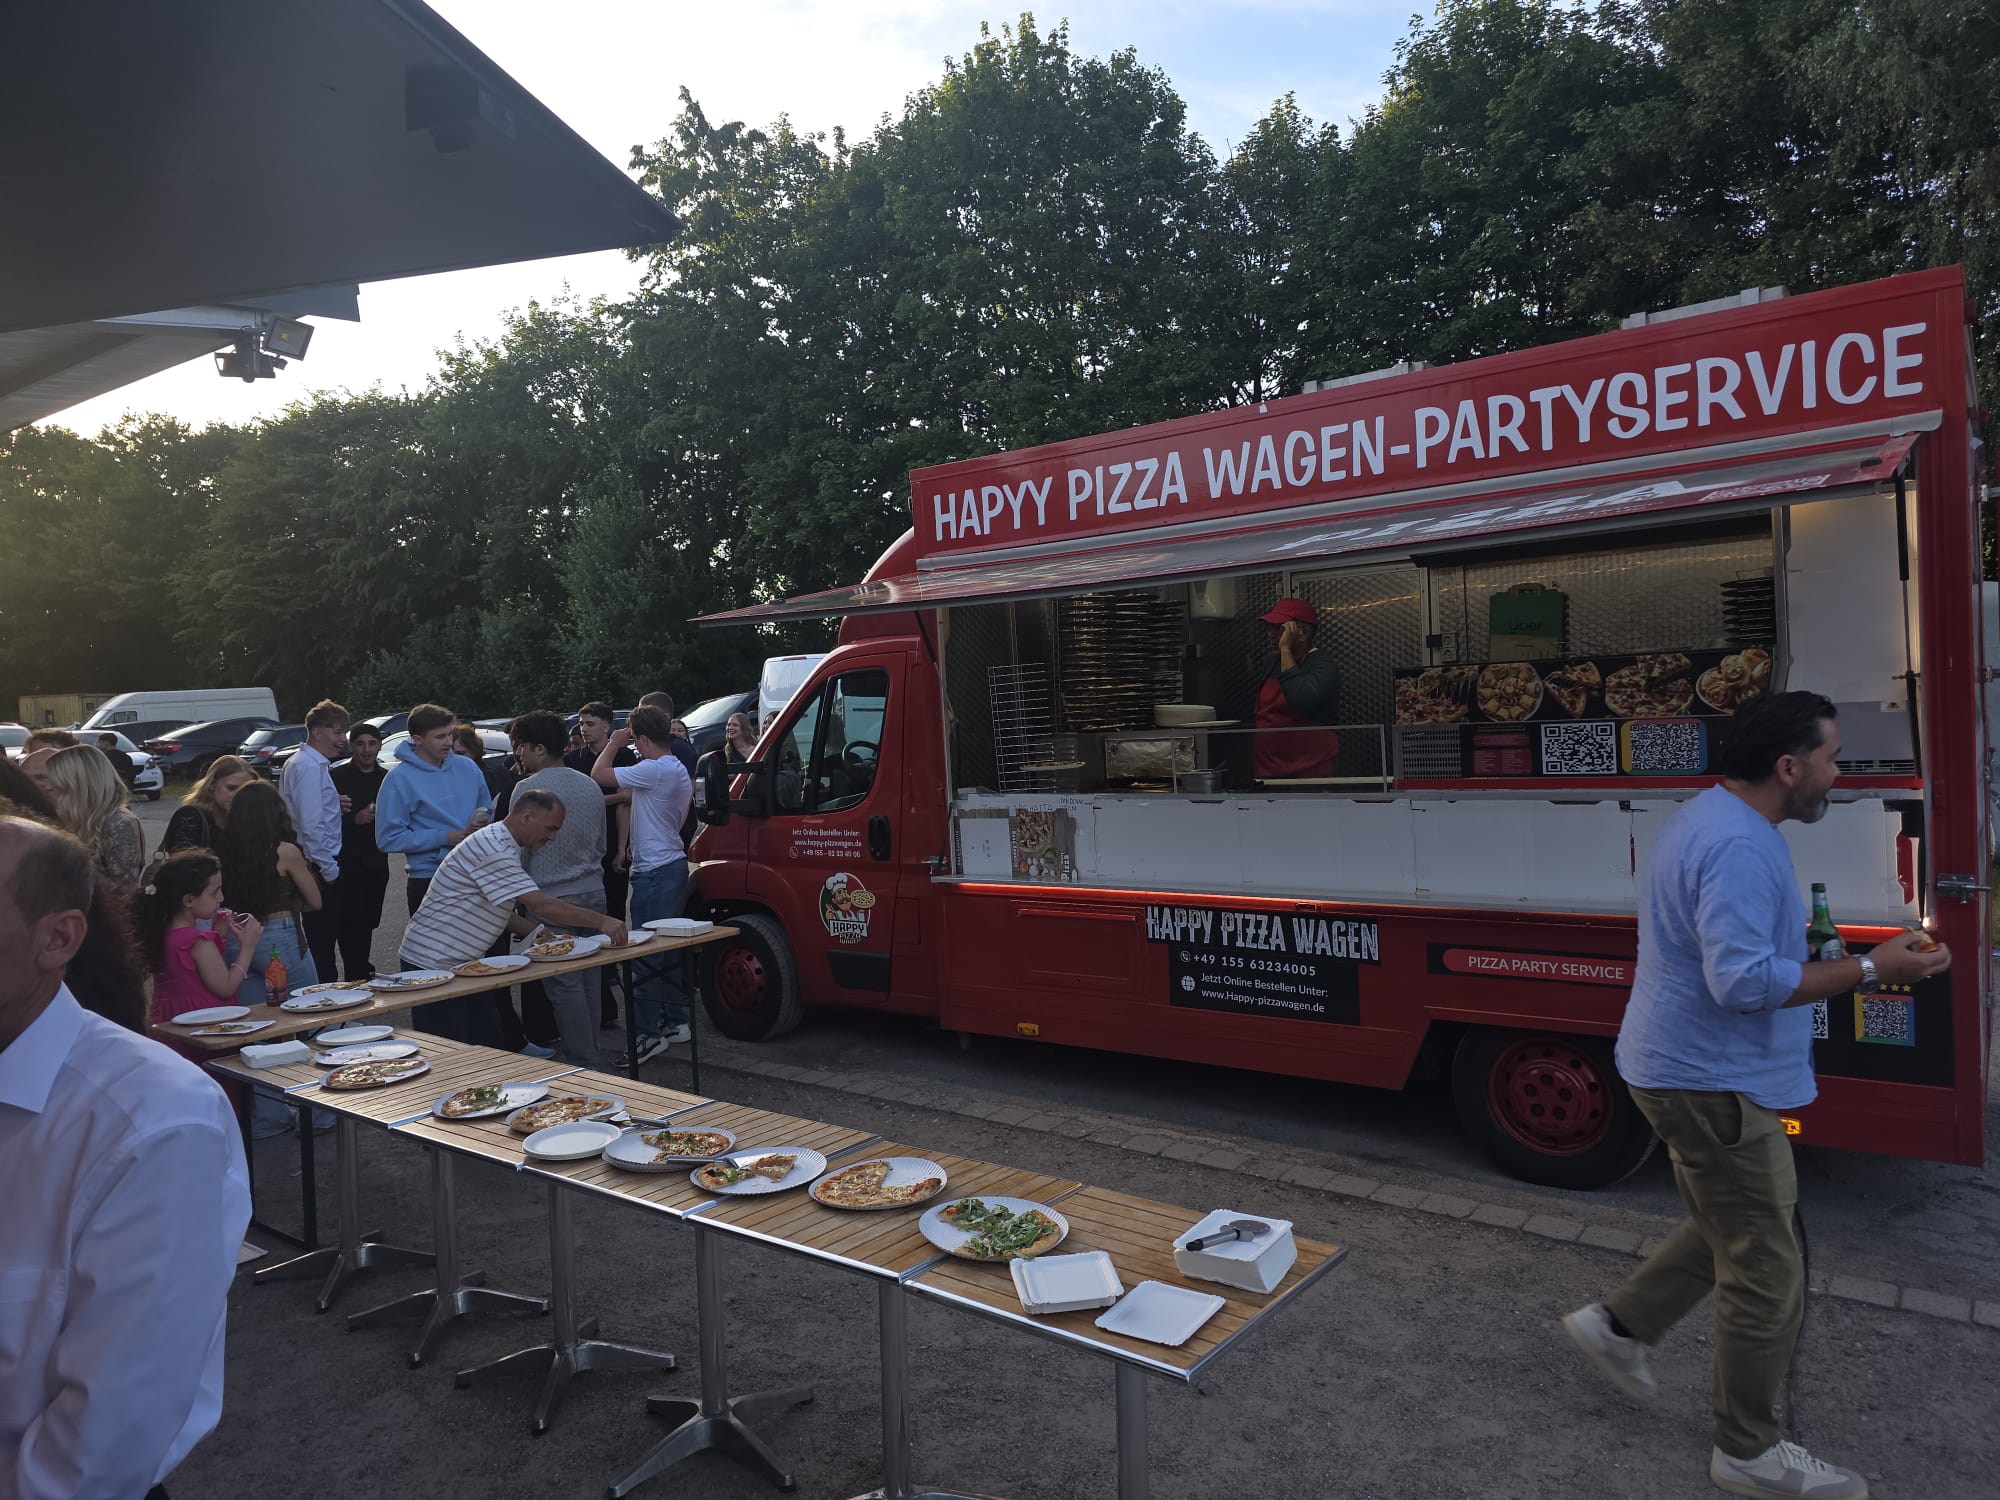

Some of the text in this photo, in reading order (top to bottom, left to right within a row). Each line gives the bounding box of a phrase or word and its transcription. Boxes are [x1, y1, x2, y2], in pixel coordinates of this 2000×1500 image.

[934, 476, 1053, 542] HAPYY
[1067, 451, 1189, 521] PIZZA
[1202, 321, 1927, 499] WAGEN-PARTYSERVICE
[802, 828, 818, 836] Online
[819, 828, 843, 837] Bestellen
[832, 921, 865, 934] HAPPY
[839, 932, 861, 940] PIZZA
[1146, 905, 1379, 961] HAPPY PIZZA WAGEN
[1193, 953, 1317, 977] +49 155 63234005
[1468, 955, 1625, 980] PIZZA PARTY SERVICE
[1200, 972, 1329, 998] Jetzt Online Bestellen Unter:
[1201, 989, 1325, 1013] www.Happy-pizzawagen.de
